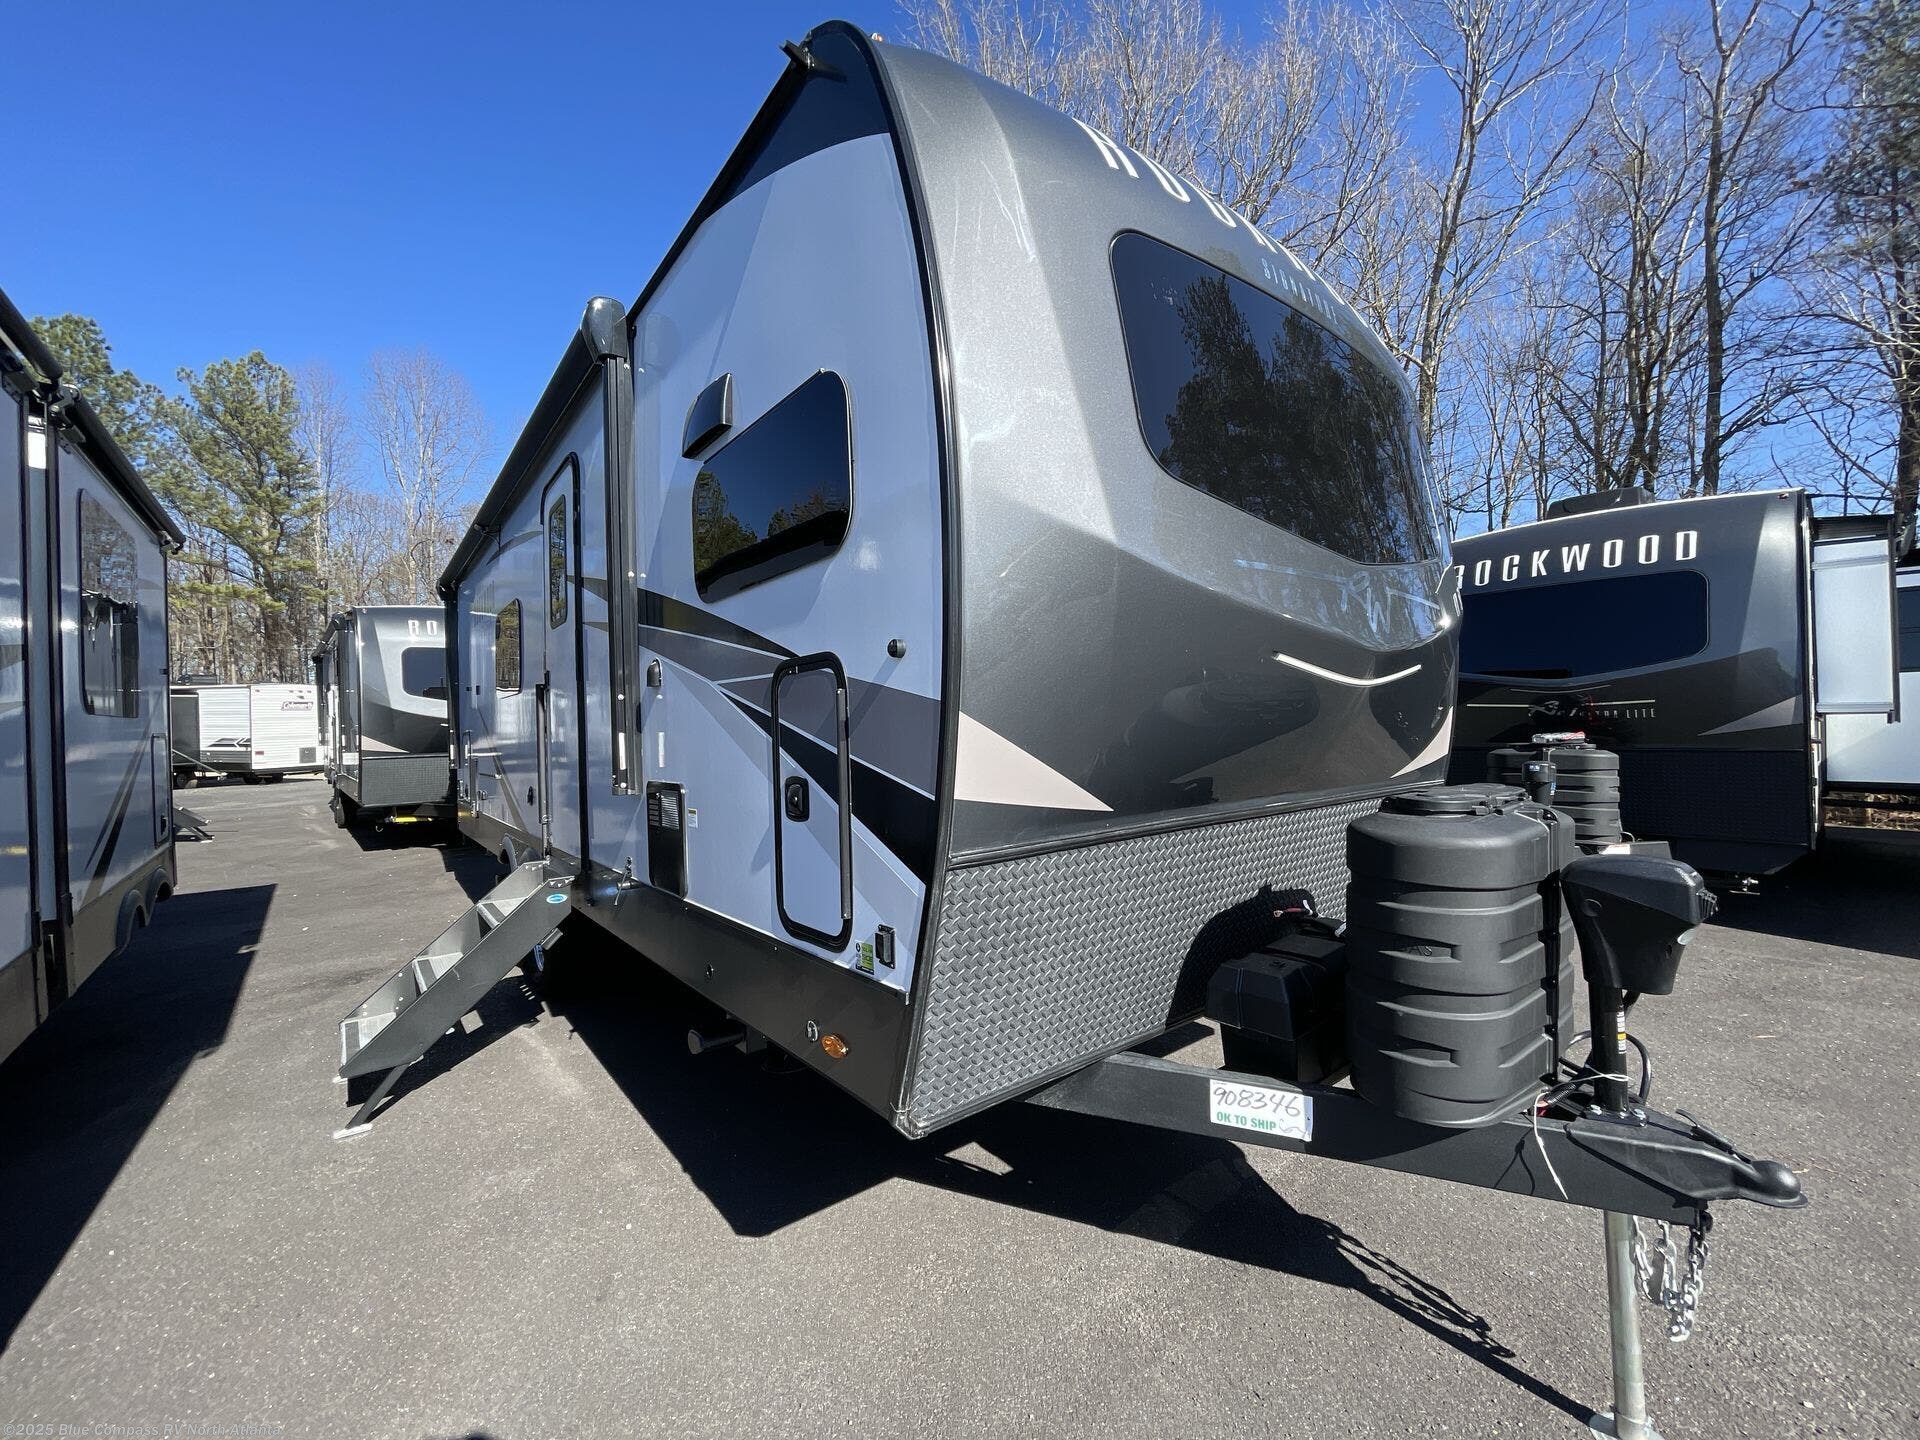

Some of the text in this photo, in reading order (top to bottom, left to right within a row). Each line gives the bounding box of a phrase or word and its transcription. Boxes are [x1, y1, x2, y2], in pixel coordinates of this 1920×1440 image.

[1626, 708, 1656, 719] LITE
[1213, 1087, 1301, 1117] 908346
[1216, 1111, 1231, 1123] OK
[1234, 1114, 1248, 1126] TO
[1251, 1117, 1277, 1131] SHIP
